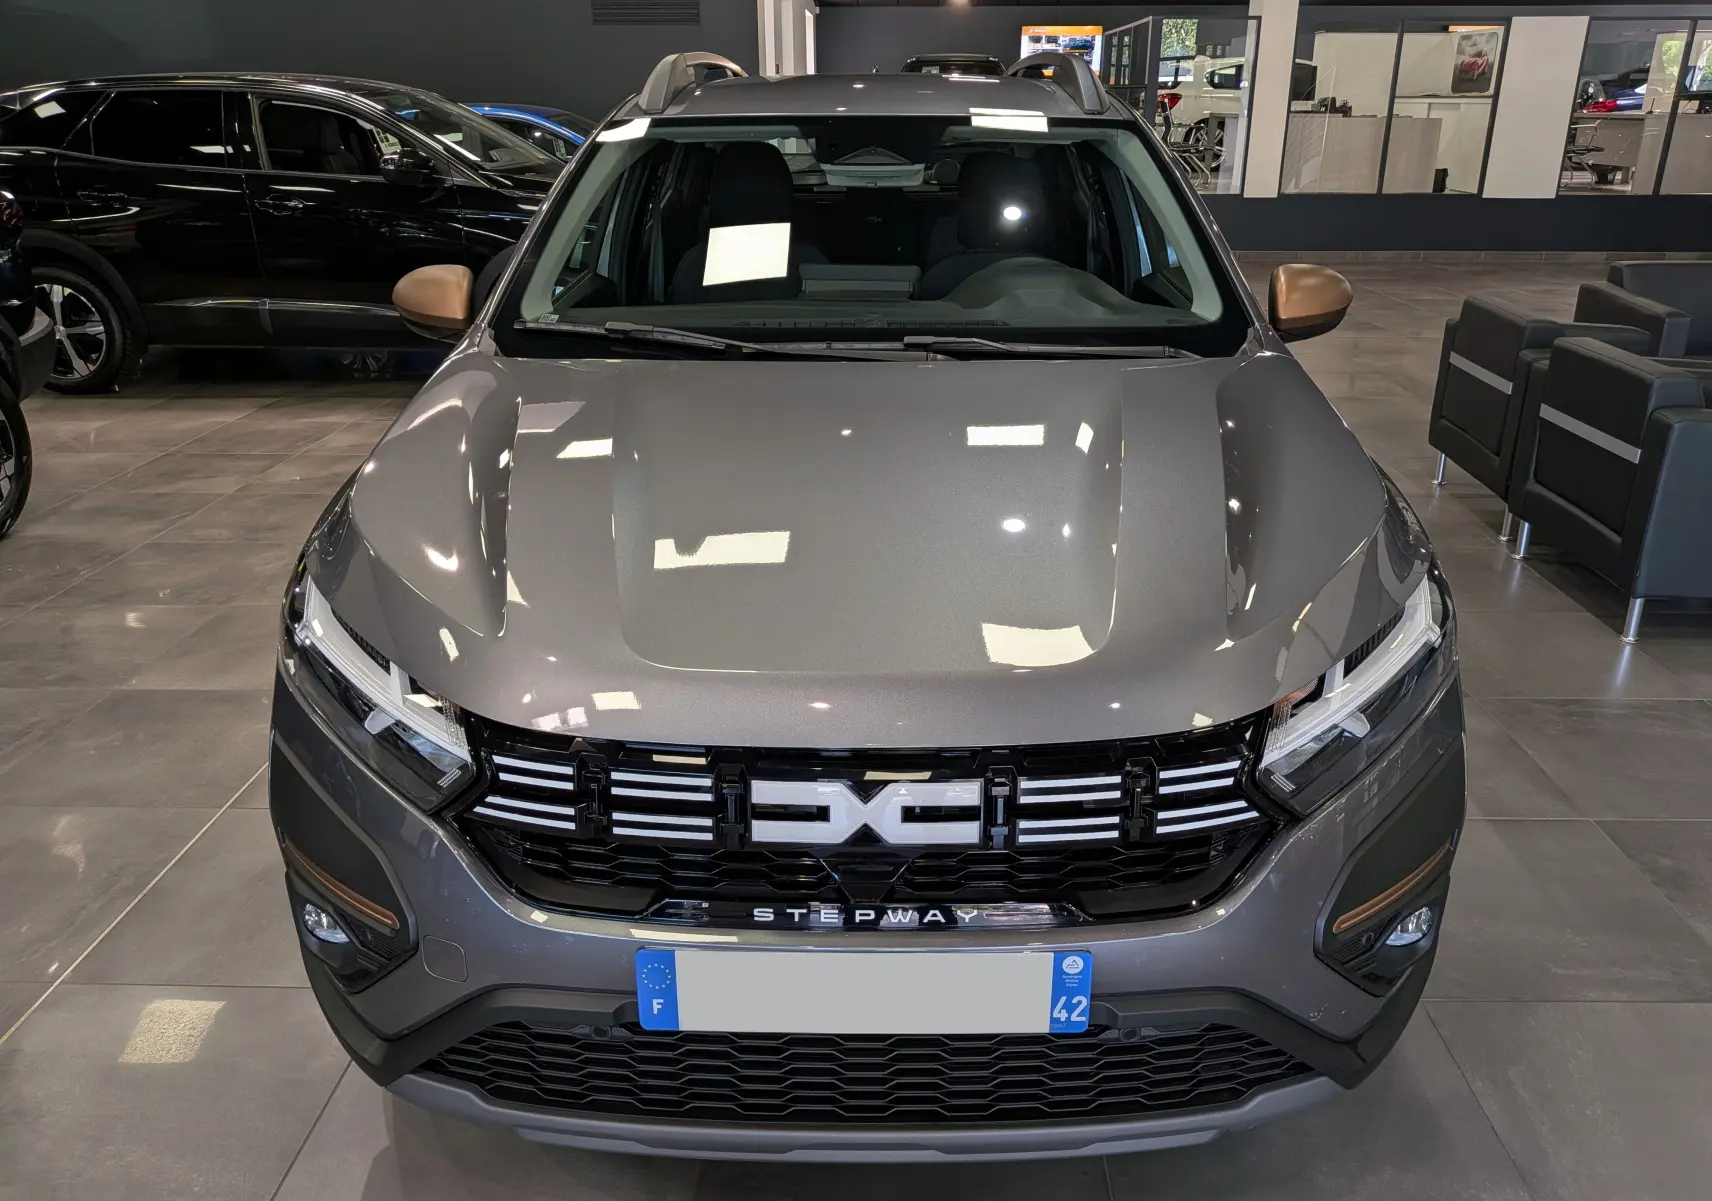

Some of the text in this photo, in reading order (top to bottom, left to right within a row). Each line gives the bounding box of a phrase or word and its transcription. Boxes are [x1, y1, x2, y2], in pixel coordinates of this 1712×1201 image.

[753, 908, 978, 923] STEPWAY
[652, 999, 664, 1015] F
[1052, 995, 1088, 1022] 42
